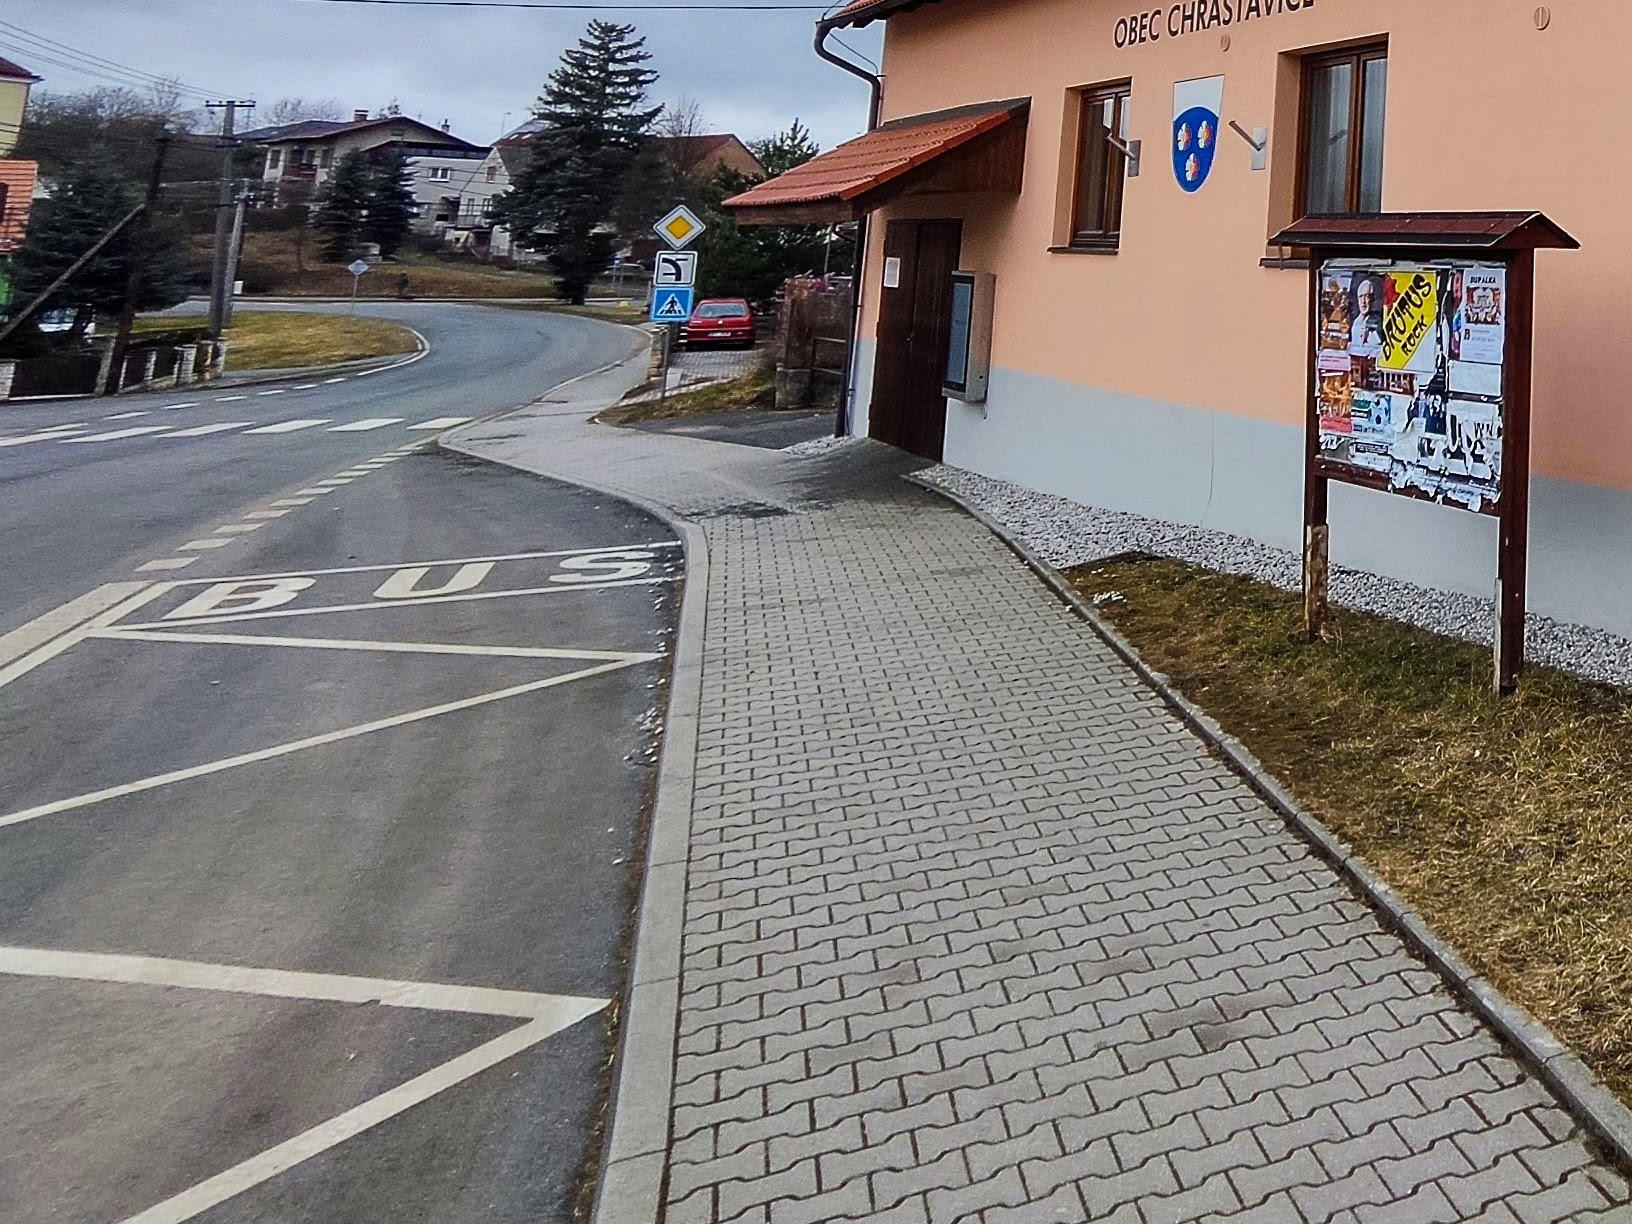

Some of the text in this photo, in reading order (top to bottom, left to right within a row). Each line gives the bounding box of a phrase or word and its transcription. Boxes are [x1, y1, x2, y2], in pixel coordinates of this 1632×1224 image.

[1114, 9, 1162, 48] OBEC
[1401, 314, 1428, 356] ROCK
[160, 550, 655, 620] BUS
